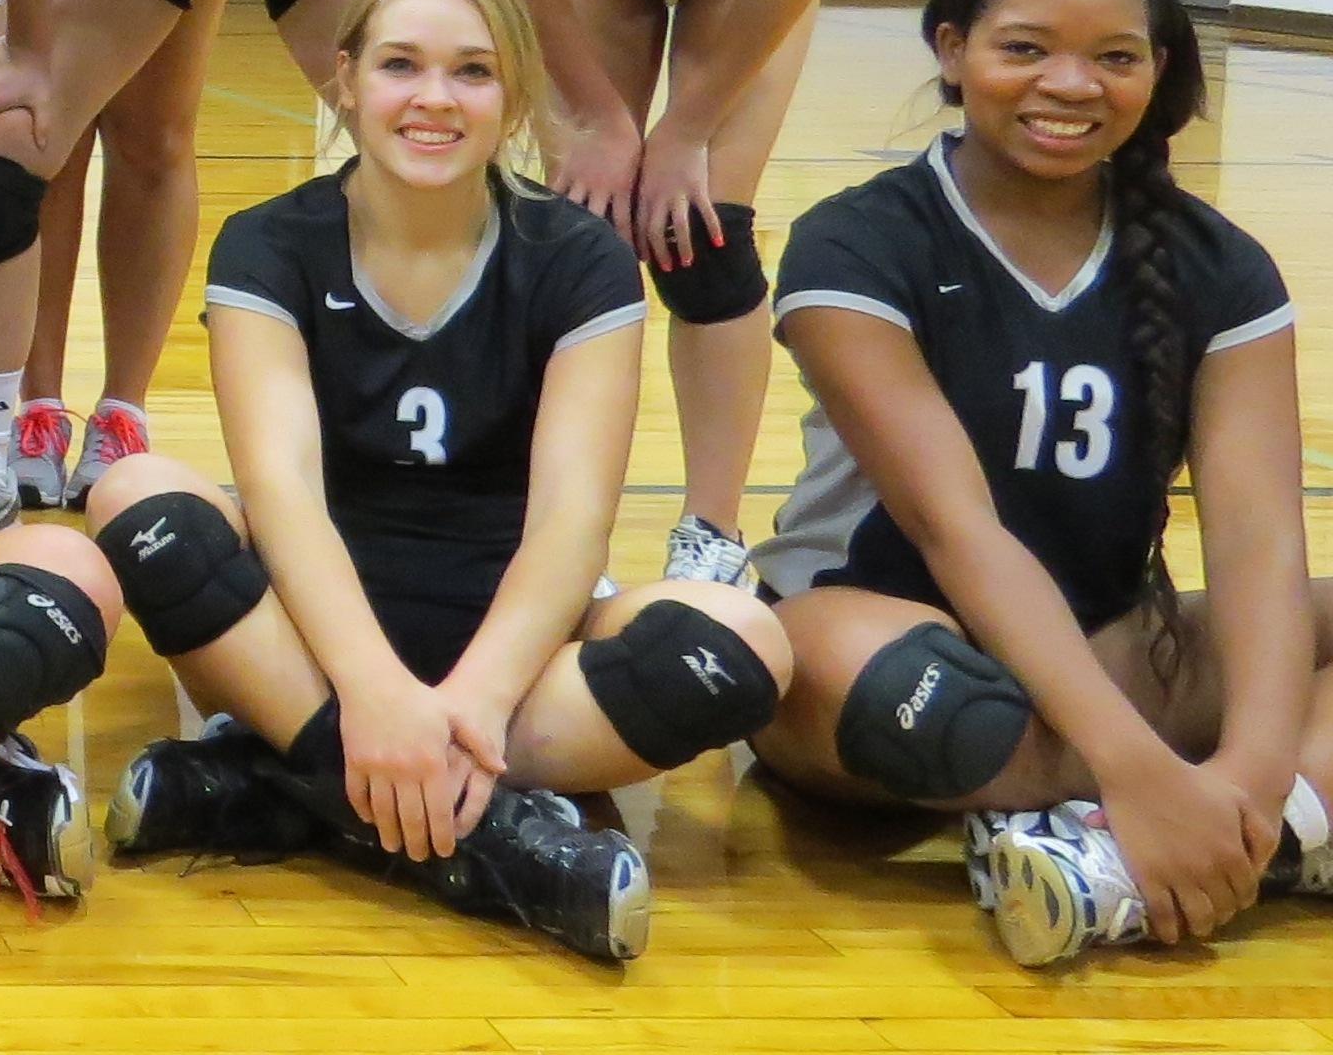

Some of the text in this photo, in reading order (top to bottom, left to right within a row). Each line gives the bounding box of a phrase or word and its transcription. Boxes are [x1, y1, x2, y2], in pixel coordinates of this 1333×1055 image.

[396, 387, 445, 464] 3
[1014, 361, 1114, 478] 13
[46, 607, 83, 645] asics
